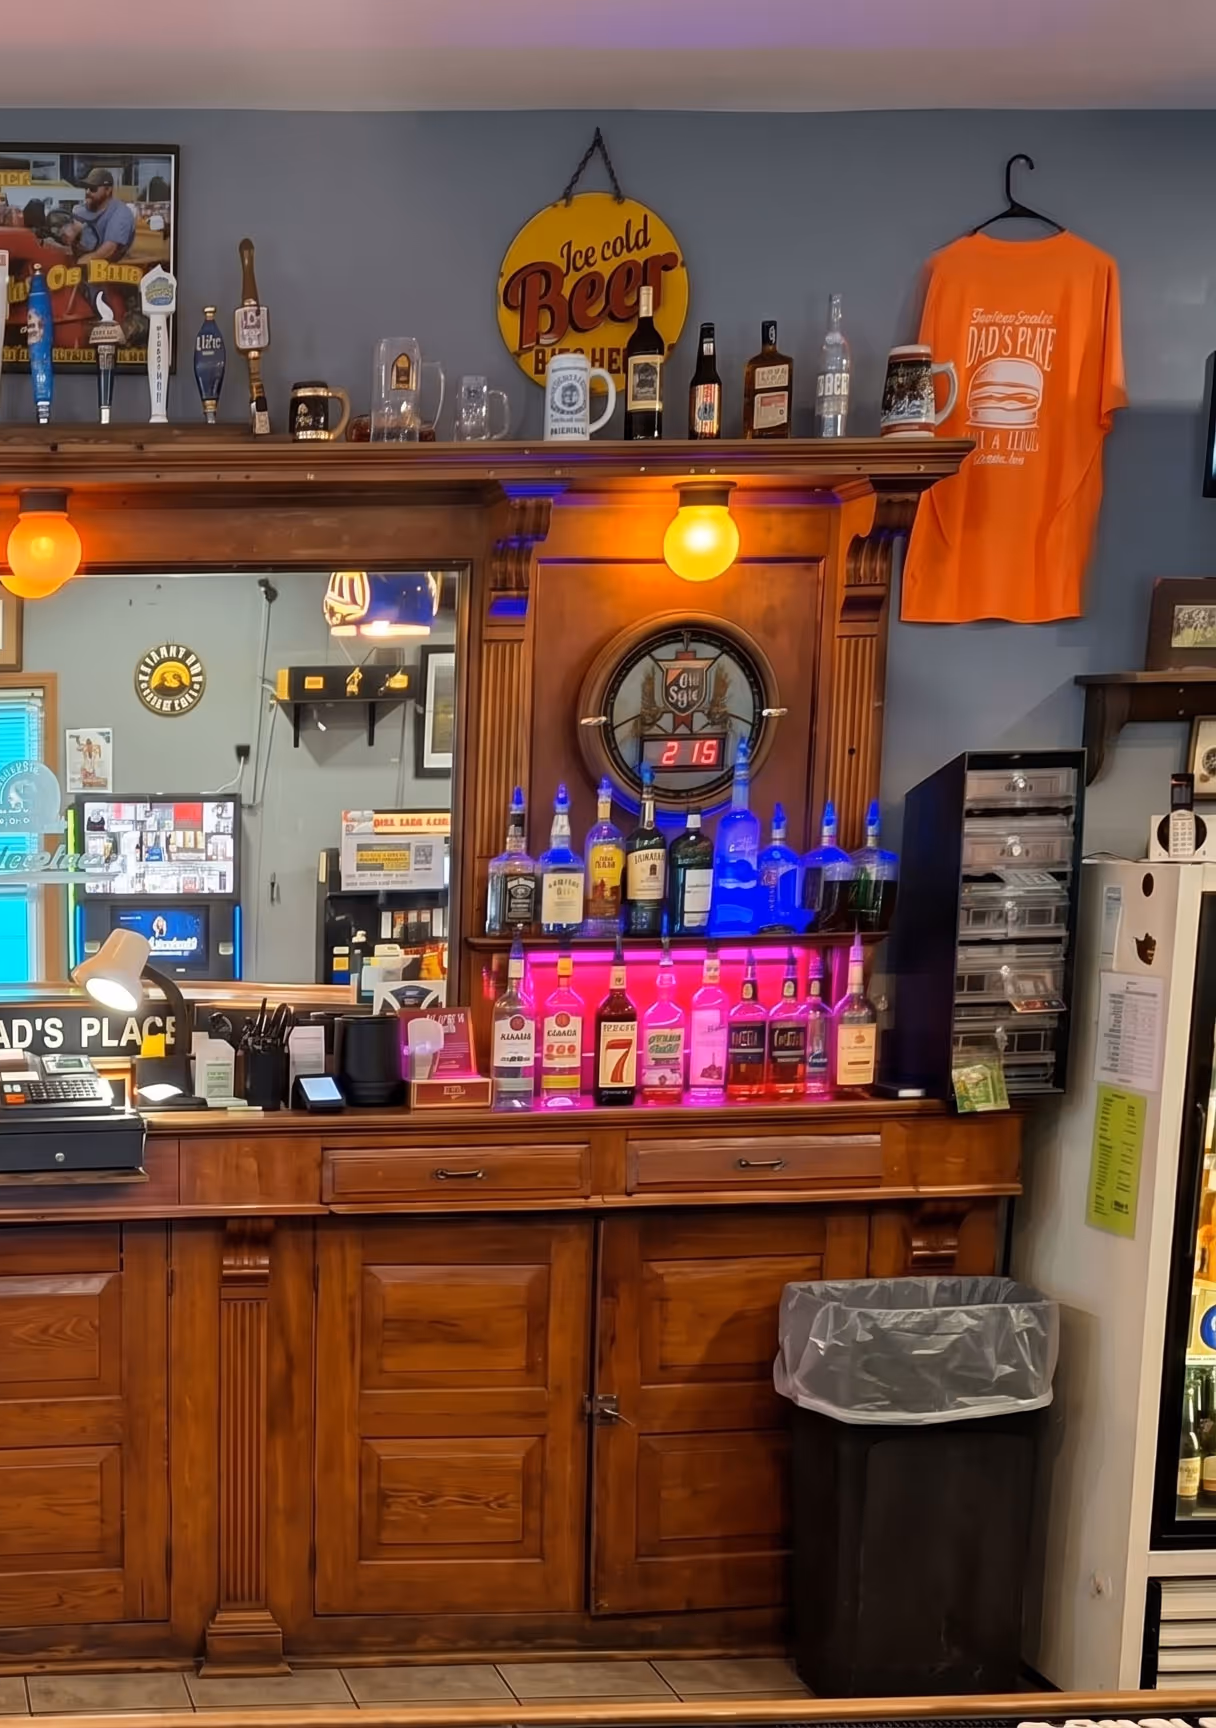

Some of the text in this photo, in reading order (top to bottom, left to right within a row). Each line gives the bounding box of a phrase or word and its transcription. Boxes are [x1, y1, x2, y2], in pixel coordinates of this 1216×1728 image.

[560, 213, 652, 276] Ice cold
[502, 251, 679, 351] Beer
[965, 325, 1013, 369] DAD'S
[661, 741, 679, 765] 2
[605, 1038, 634, 1084] 7
